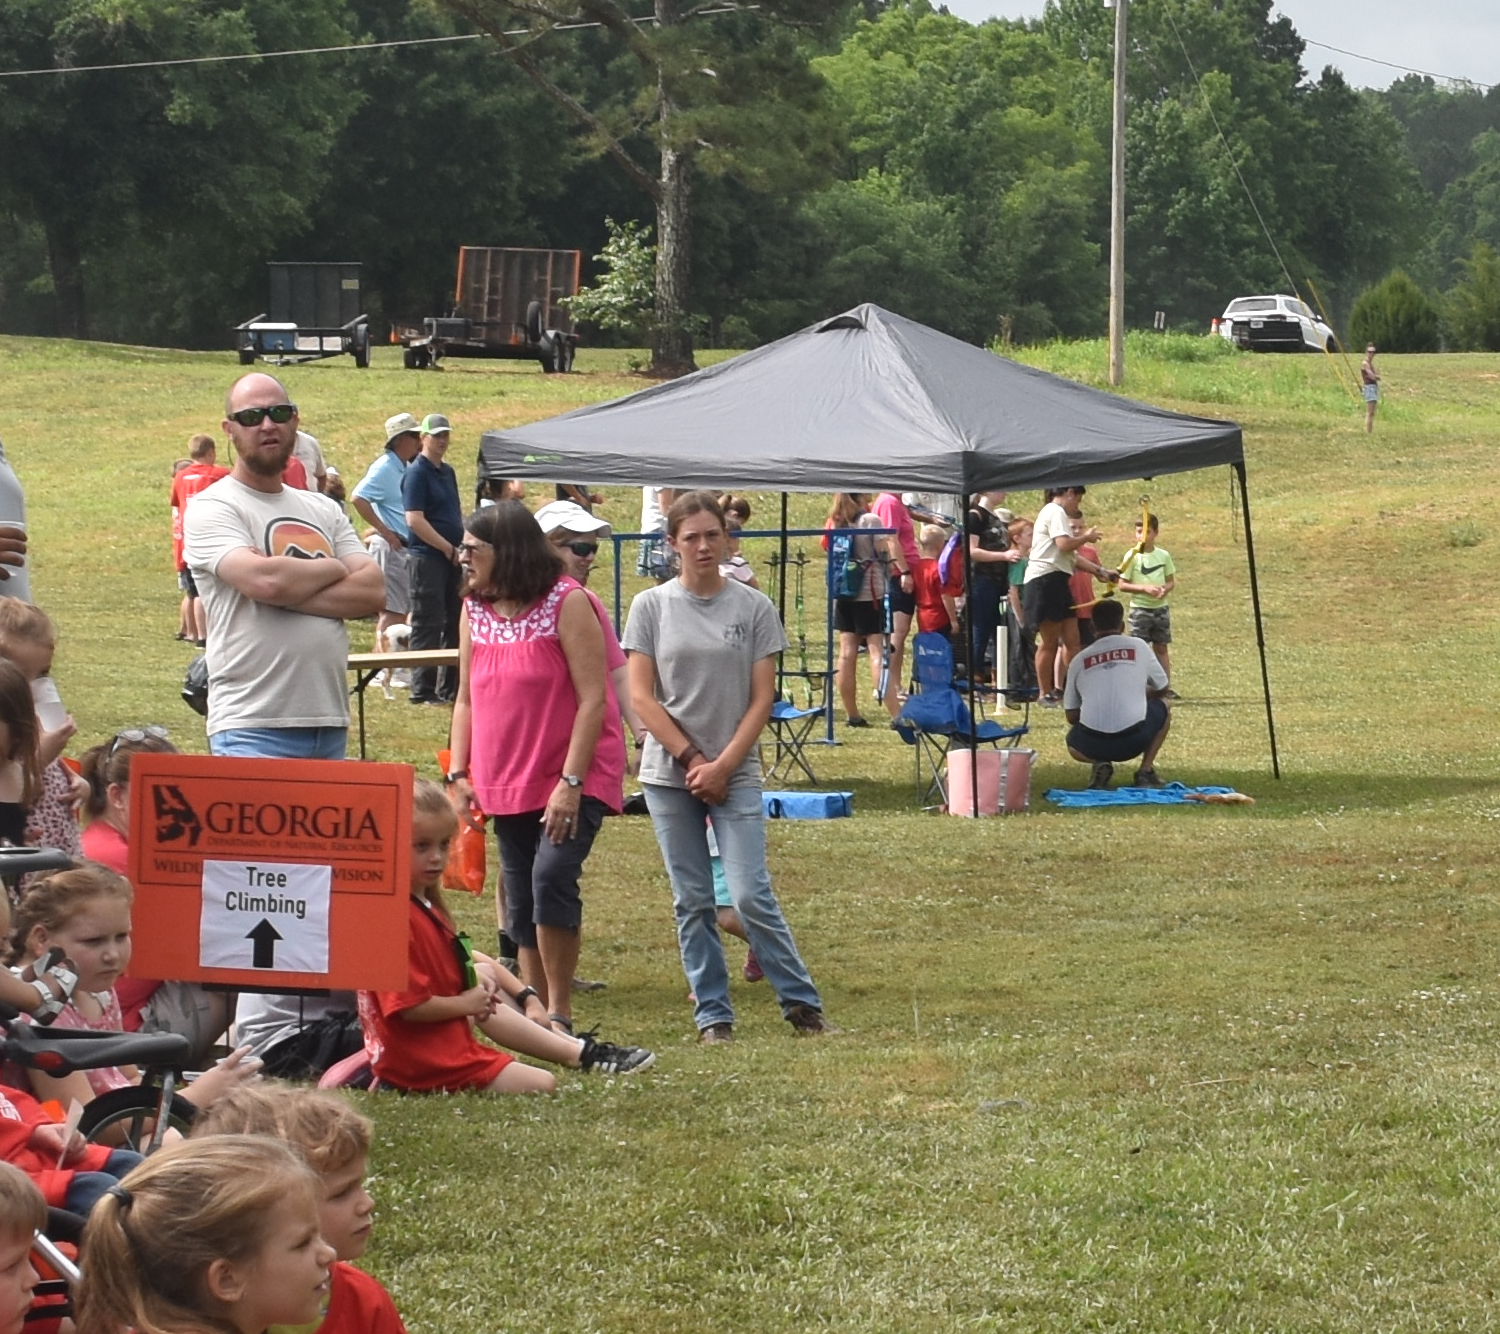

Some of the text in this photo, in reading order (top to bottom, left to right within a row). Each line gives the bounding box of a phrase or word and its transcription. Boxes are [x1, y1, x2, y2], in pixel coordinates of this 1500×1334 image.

[205, 801, 383, 840] GEORGIA
[245, 866, 287, 888] Tree
[331, 867, 384, 881] VISION
[225, 891, 306, 920] Climbing
